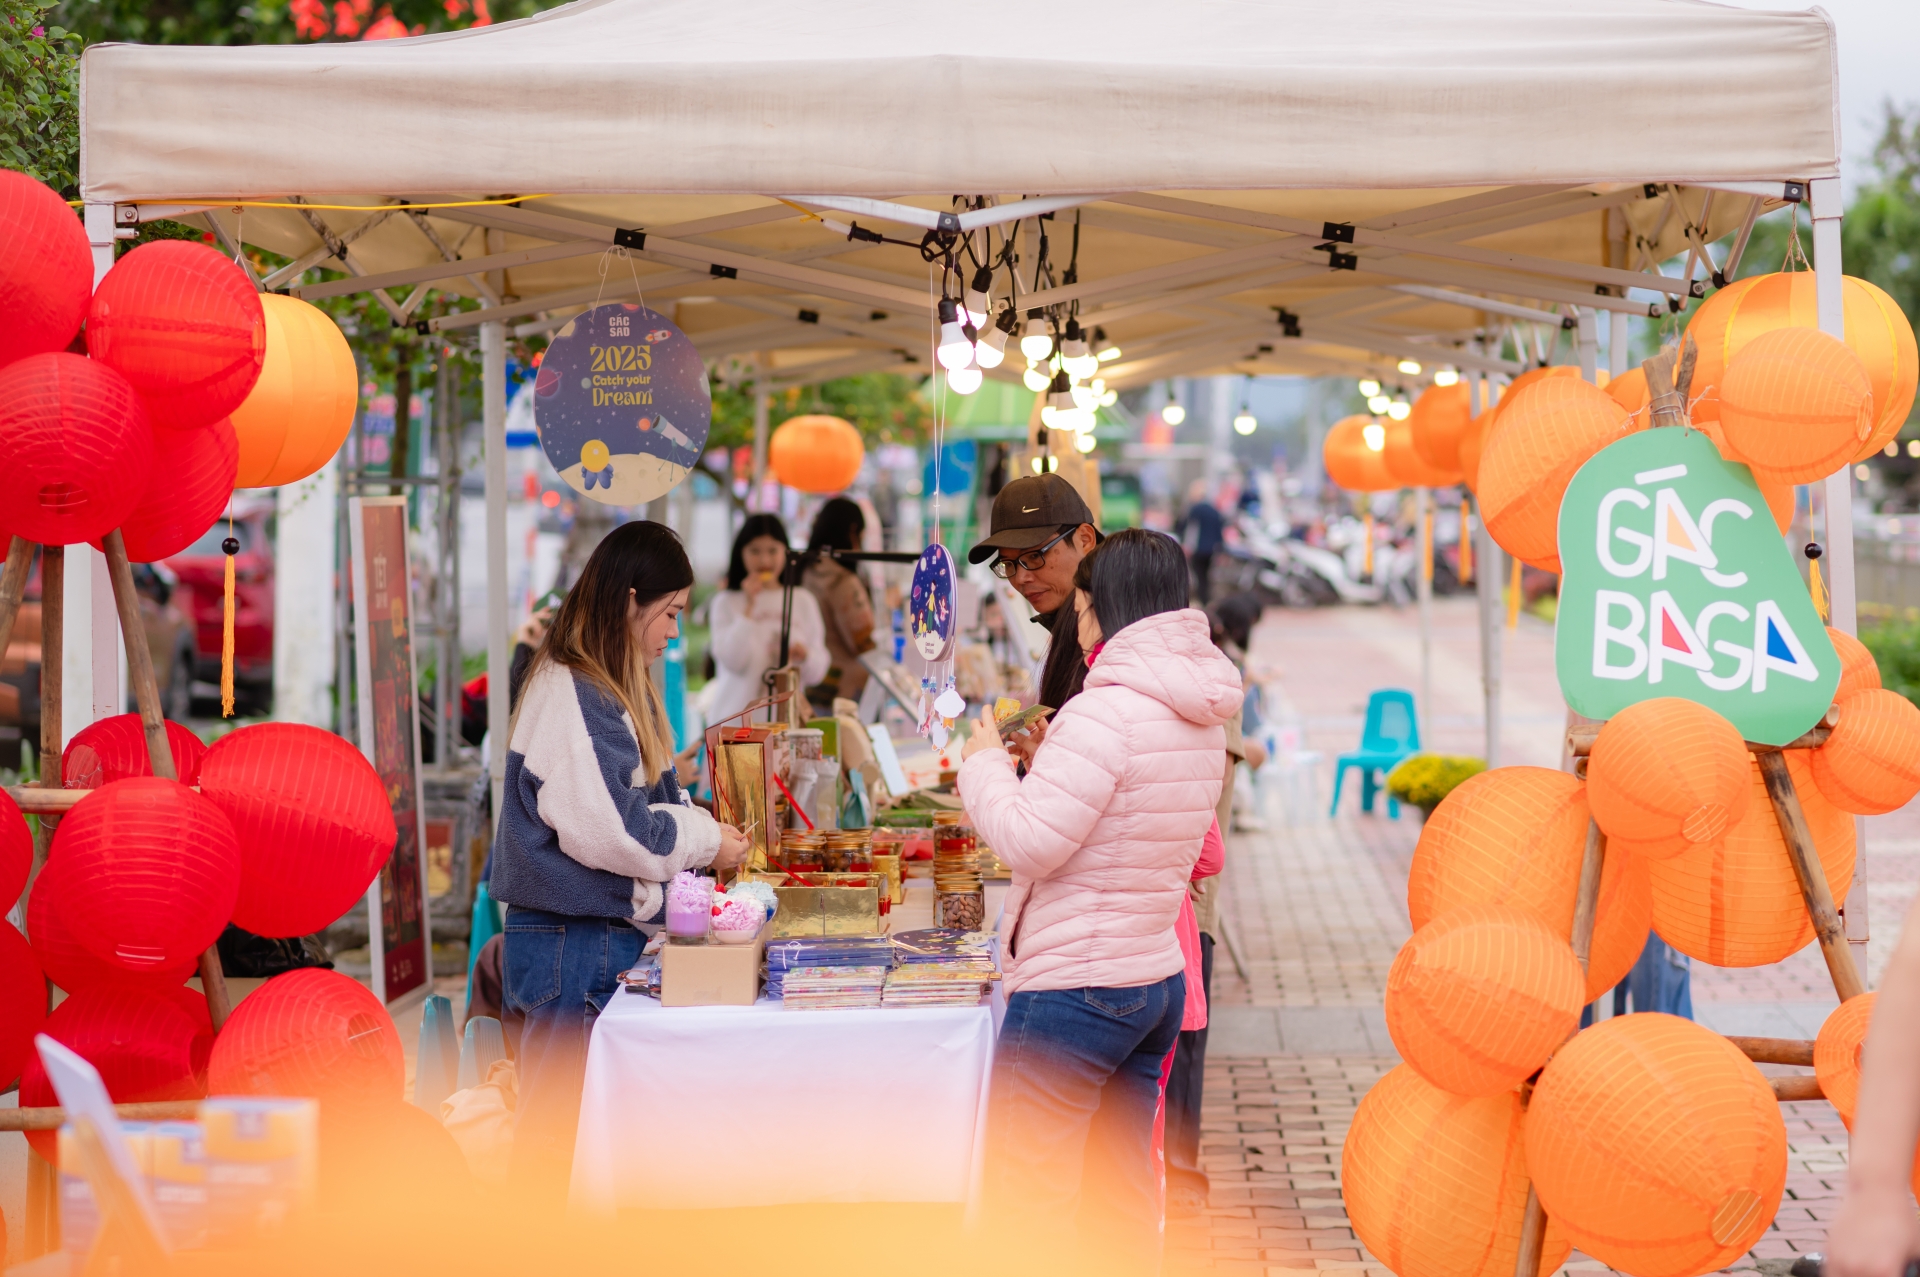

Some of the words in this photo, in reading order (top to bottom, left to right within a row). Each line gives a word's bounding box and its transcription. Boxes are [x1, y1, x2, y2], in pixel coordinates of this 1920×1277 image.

[609, 313, 630, 326] CÁC
[609, 327, 630, 337] SAO
[590, 345, 652, 372] 2025
[592, 374, 624, 386] Catch
[626, 376, 651, 387] your
[592, 387, 653, 406] Dream
[1592, 589, 1820, 693] BAGA
